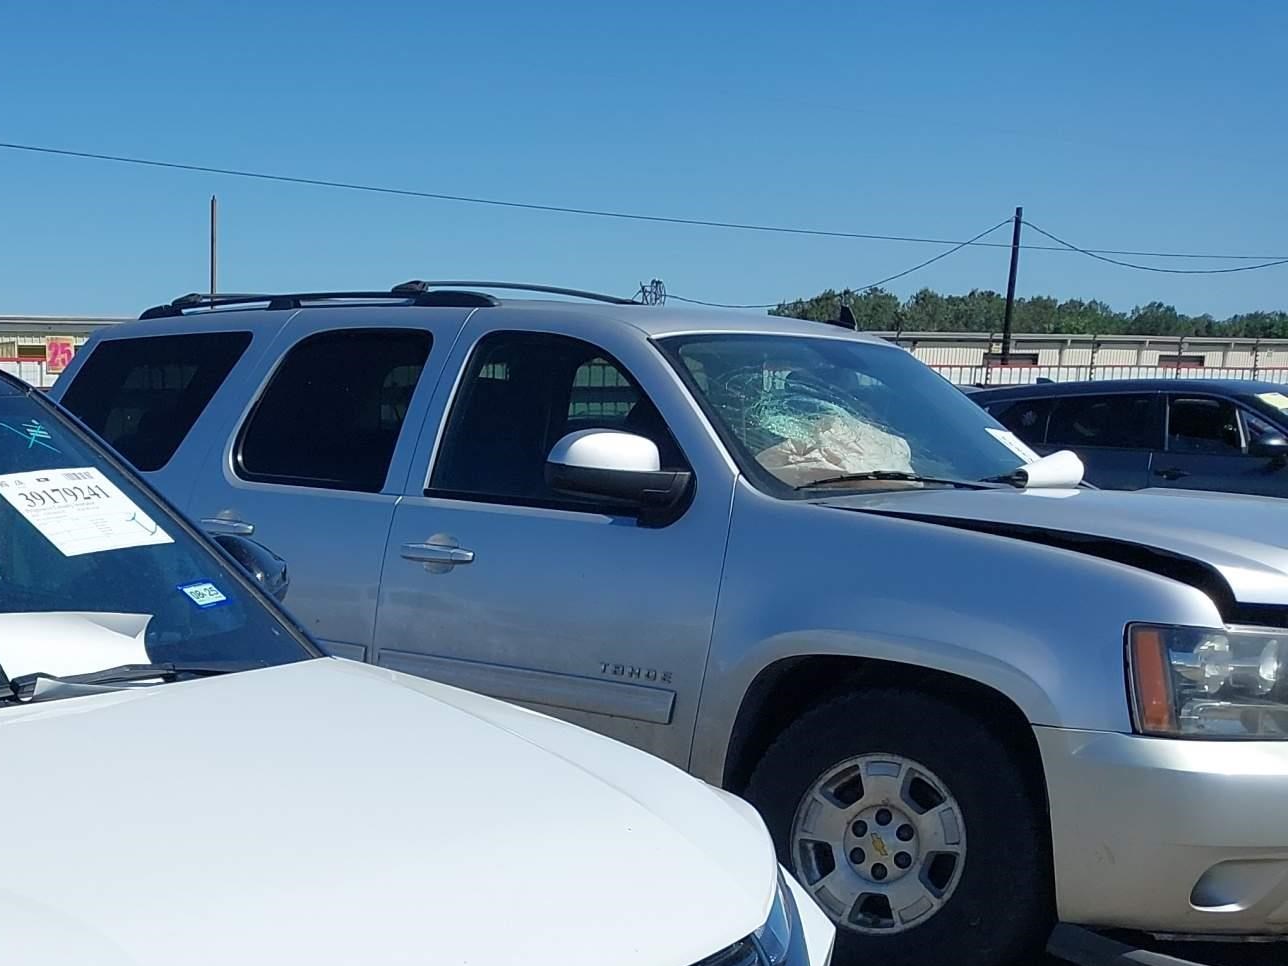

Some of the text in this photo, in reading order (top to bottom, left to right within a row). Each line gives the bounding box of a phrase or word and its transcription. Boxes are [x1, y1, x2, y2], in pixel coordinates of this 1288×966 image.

[48, 341, 72, 367] 25
[19, 485, 110, 507] 39179241
[600, 661, 673, 684] TAHOE
